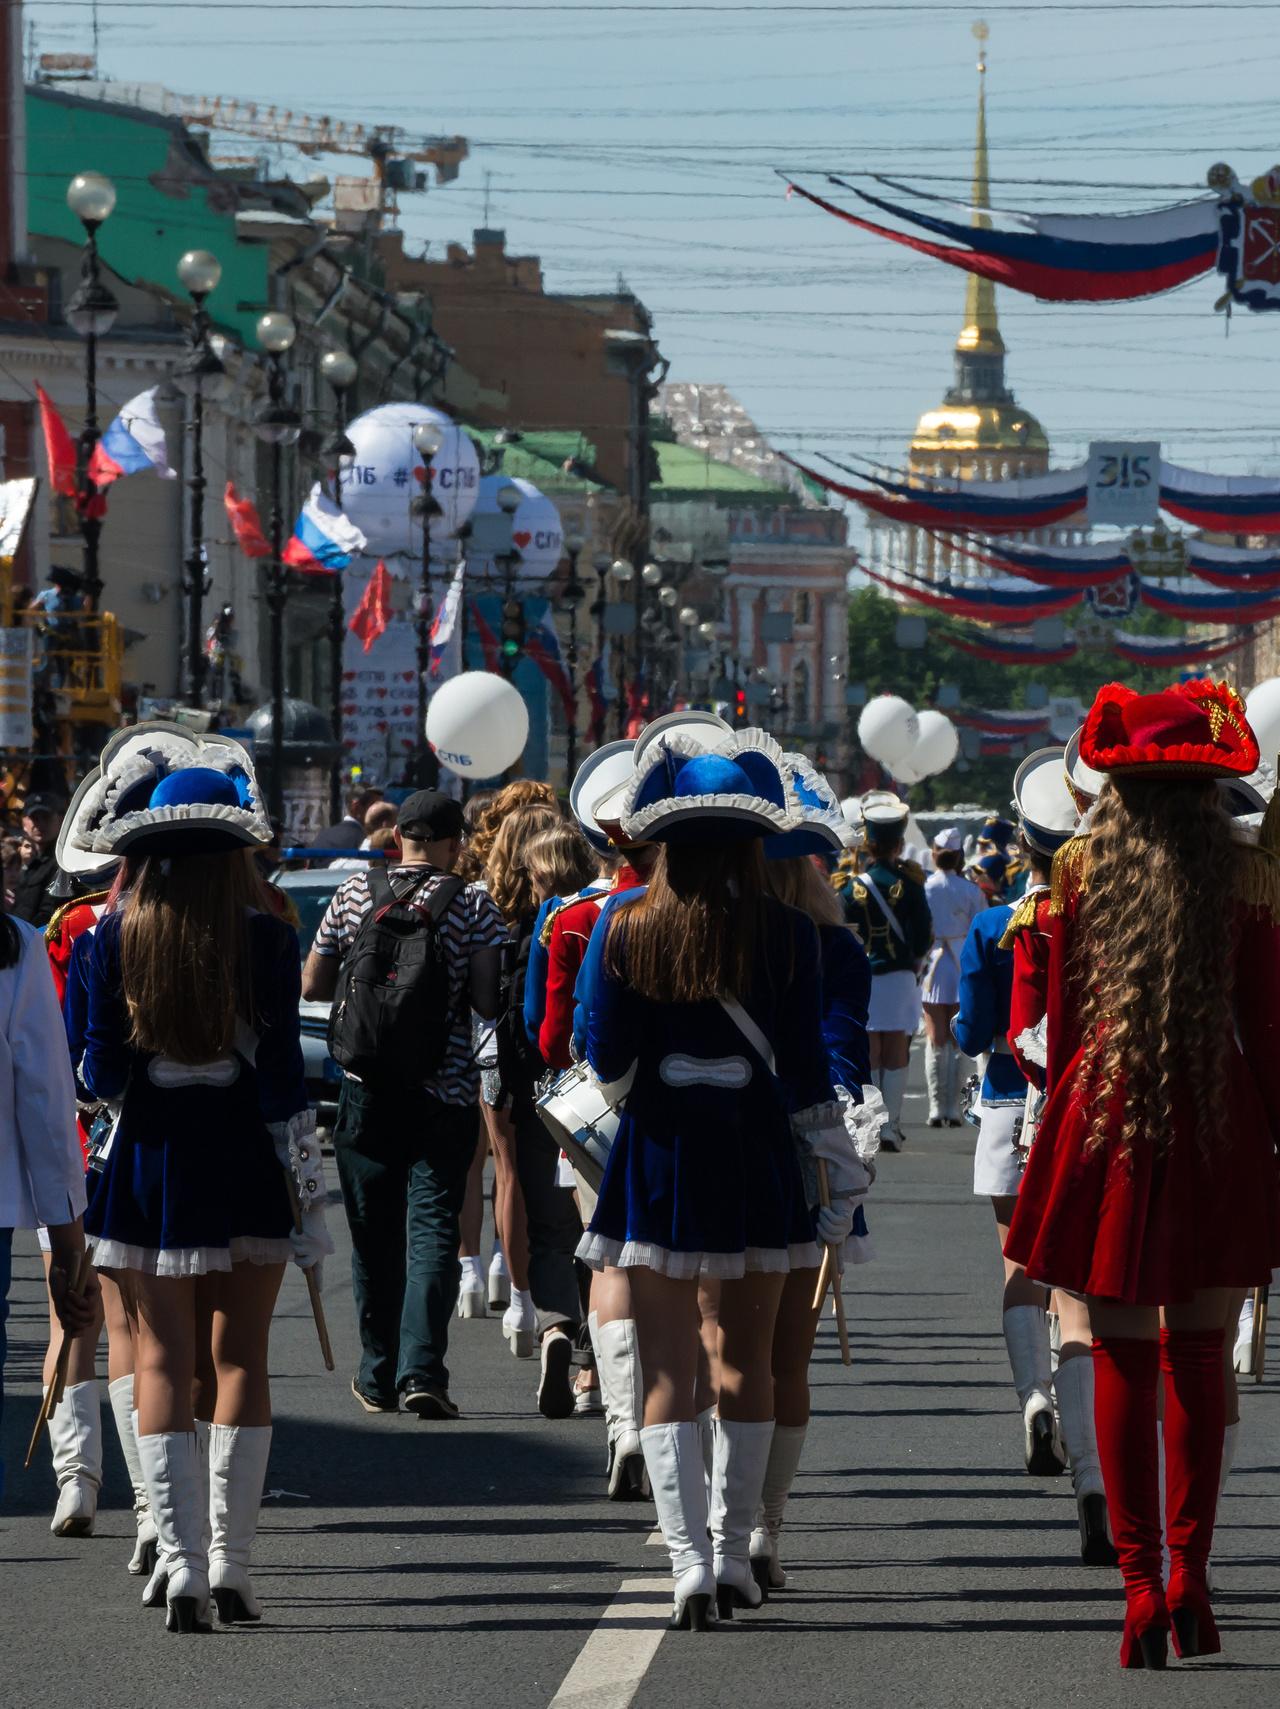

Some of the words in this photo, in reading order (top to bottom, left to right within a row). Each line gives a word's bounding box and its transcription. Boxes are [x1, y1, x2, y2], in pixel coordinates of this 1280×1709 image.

[440, 467, 475, 488] СПБ
[1096, 451, 1151, 489] 315
[438, 749, 472, 766] СПБ
